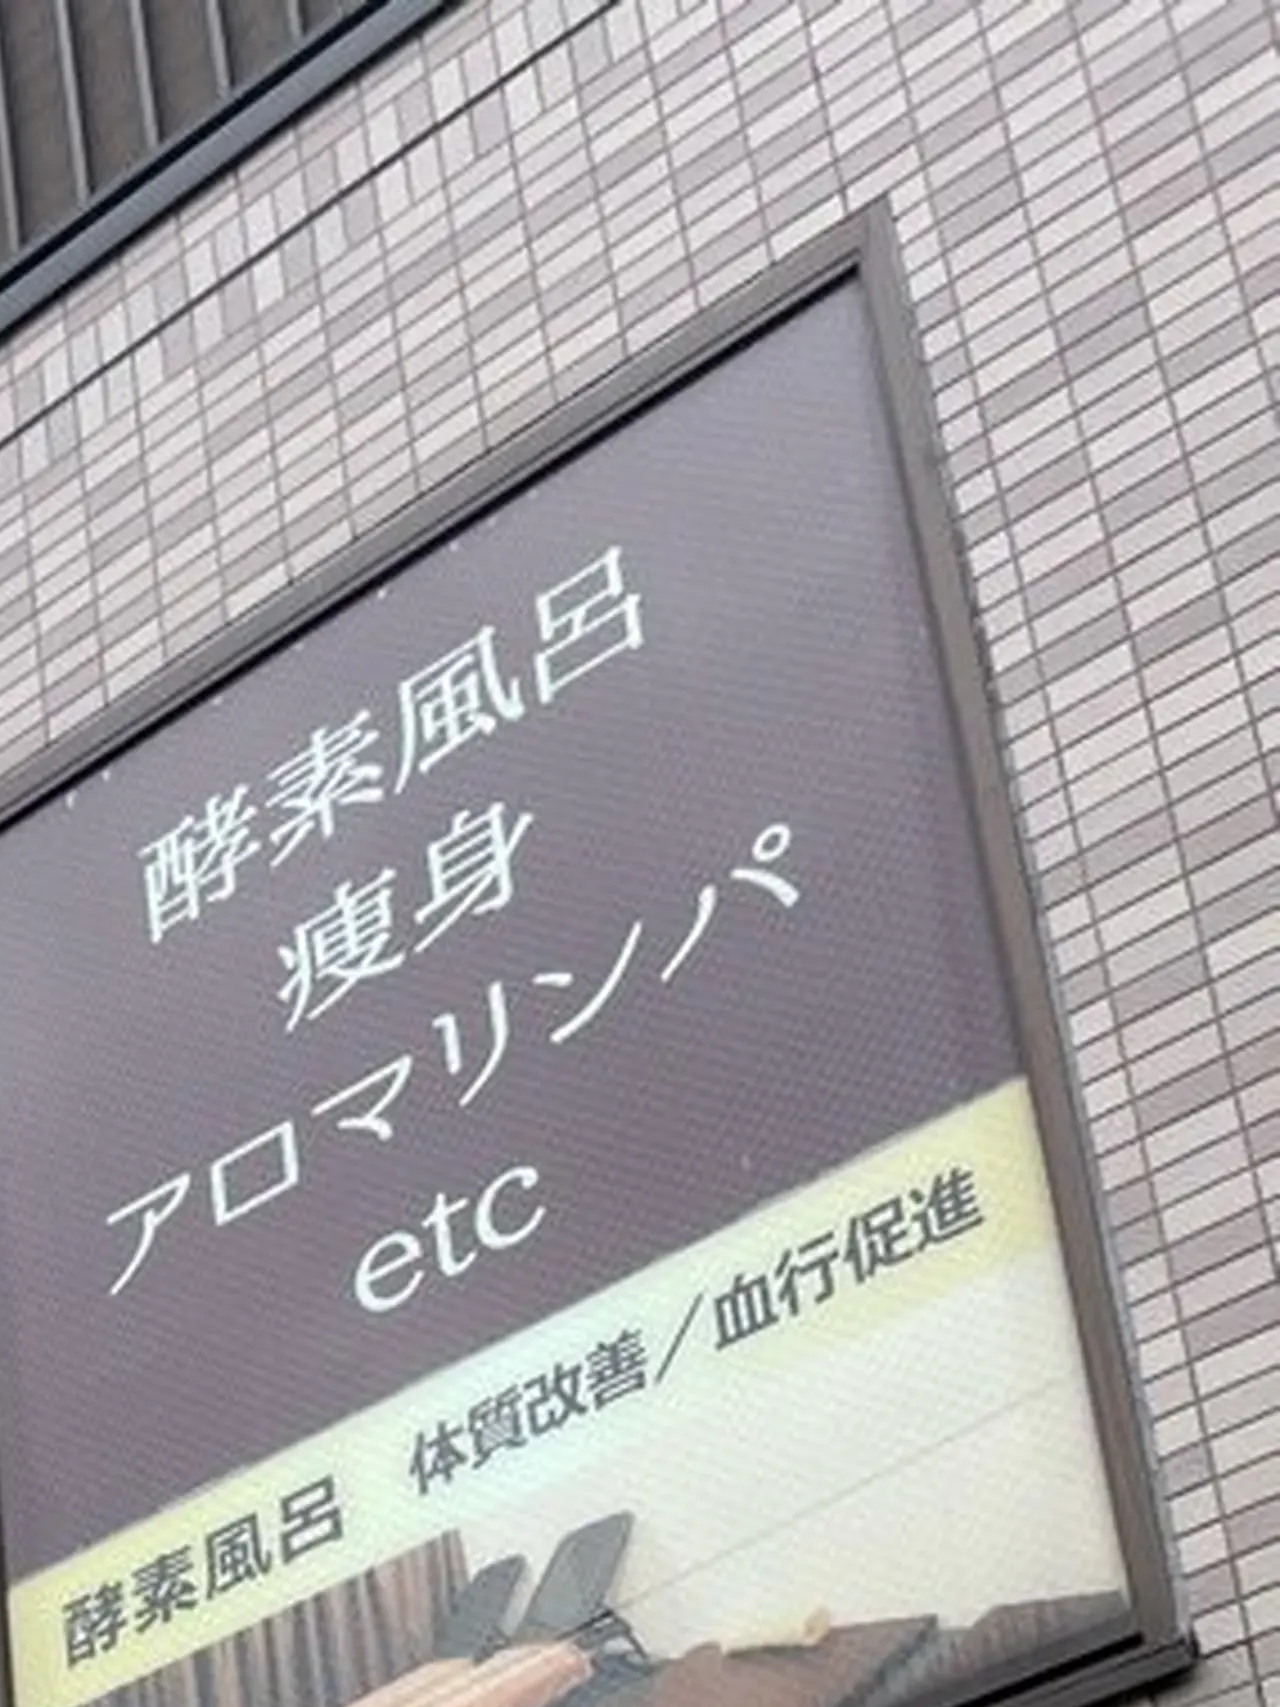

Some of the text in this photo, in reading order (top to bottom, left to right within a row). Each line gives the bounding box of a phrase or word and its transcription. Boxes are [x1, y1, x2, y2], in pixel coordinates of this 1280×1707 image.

[138, 546, 644, 944] 酵素風呂
[278, 802, 534, 1033] 痩身
[107, 824, 799, 1297] アロマリンパ
[354, 1165, 546, 1313] etc
[61, 1475, 343, 1672] 酵素風呂
